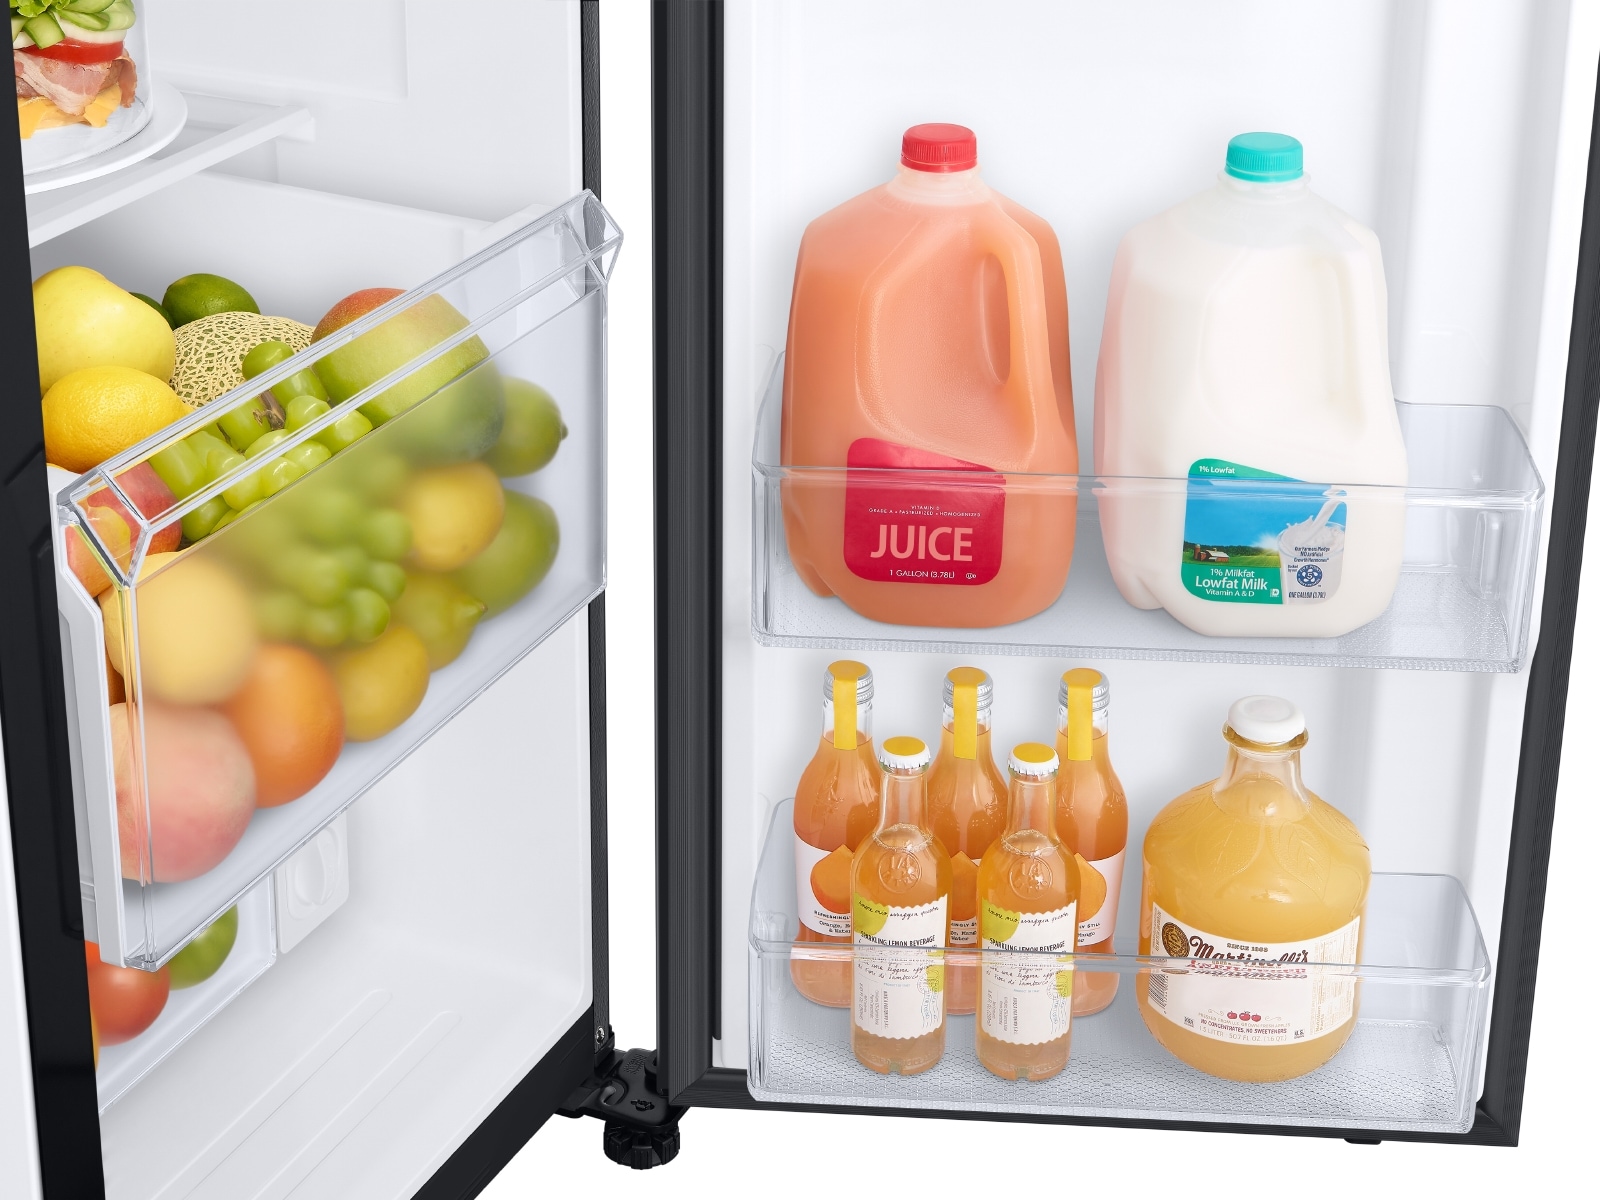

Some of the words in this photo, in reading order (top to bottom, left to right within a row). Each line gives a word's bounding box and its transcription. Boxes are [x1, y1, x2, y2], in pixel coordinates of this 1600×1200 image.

[1210, 466, 1236, 474] Lowfat
[870, 524, 974, 562] JUICE
[896, 569, 929, 578] GALLON
[930, 571, 955, 579] (3.78L)
[1210, 568, 1223, 576] 1%
[1224, 569, 1256, 578] Milkfat
[1195, 576, 1239, 589] Lowfat
[1241, 578, 1269, 591] Milk
[1205, 588, 1234, 596] Vitamin
[860, 930, 888, 946] SPARKLING
[909, 934, 936, 947] BEVERAGE
[989, 937, 1018, 952] SPARKLING
[1040, 940, 1066, 952] BEVERAGE
[1226, 942, 1250, 951] SINCE
[1207, 1020, 1246, 1033] CONCENTRATES,
[1207, 1028, 1224, 1037] LITER
